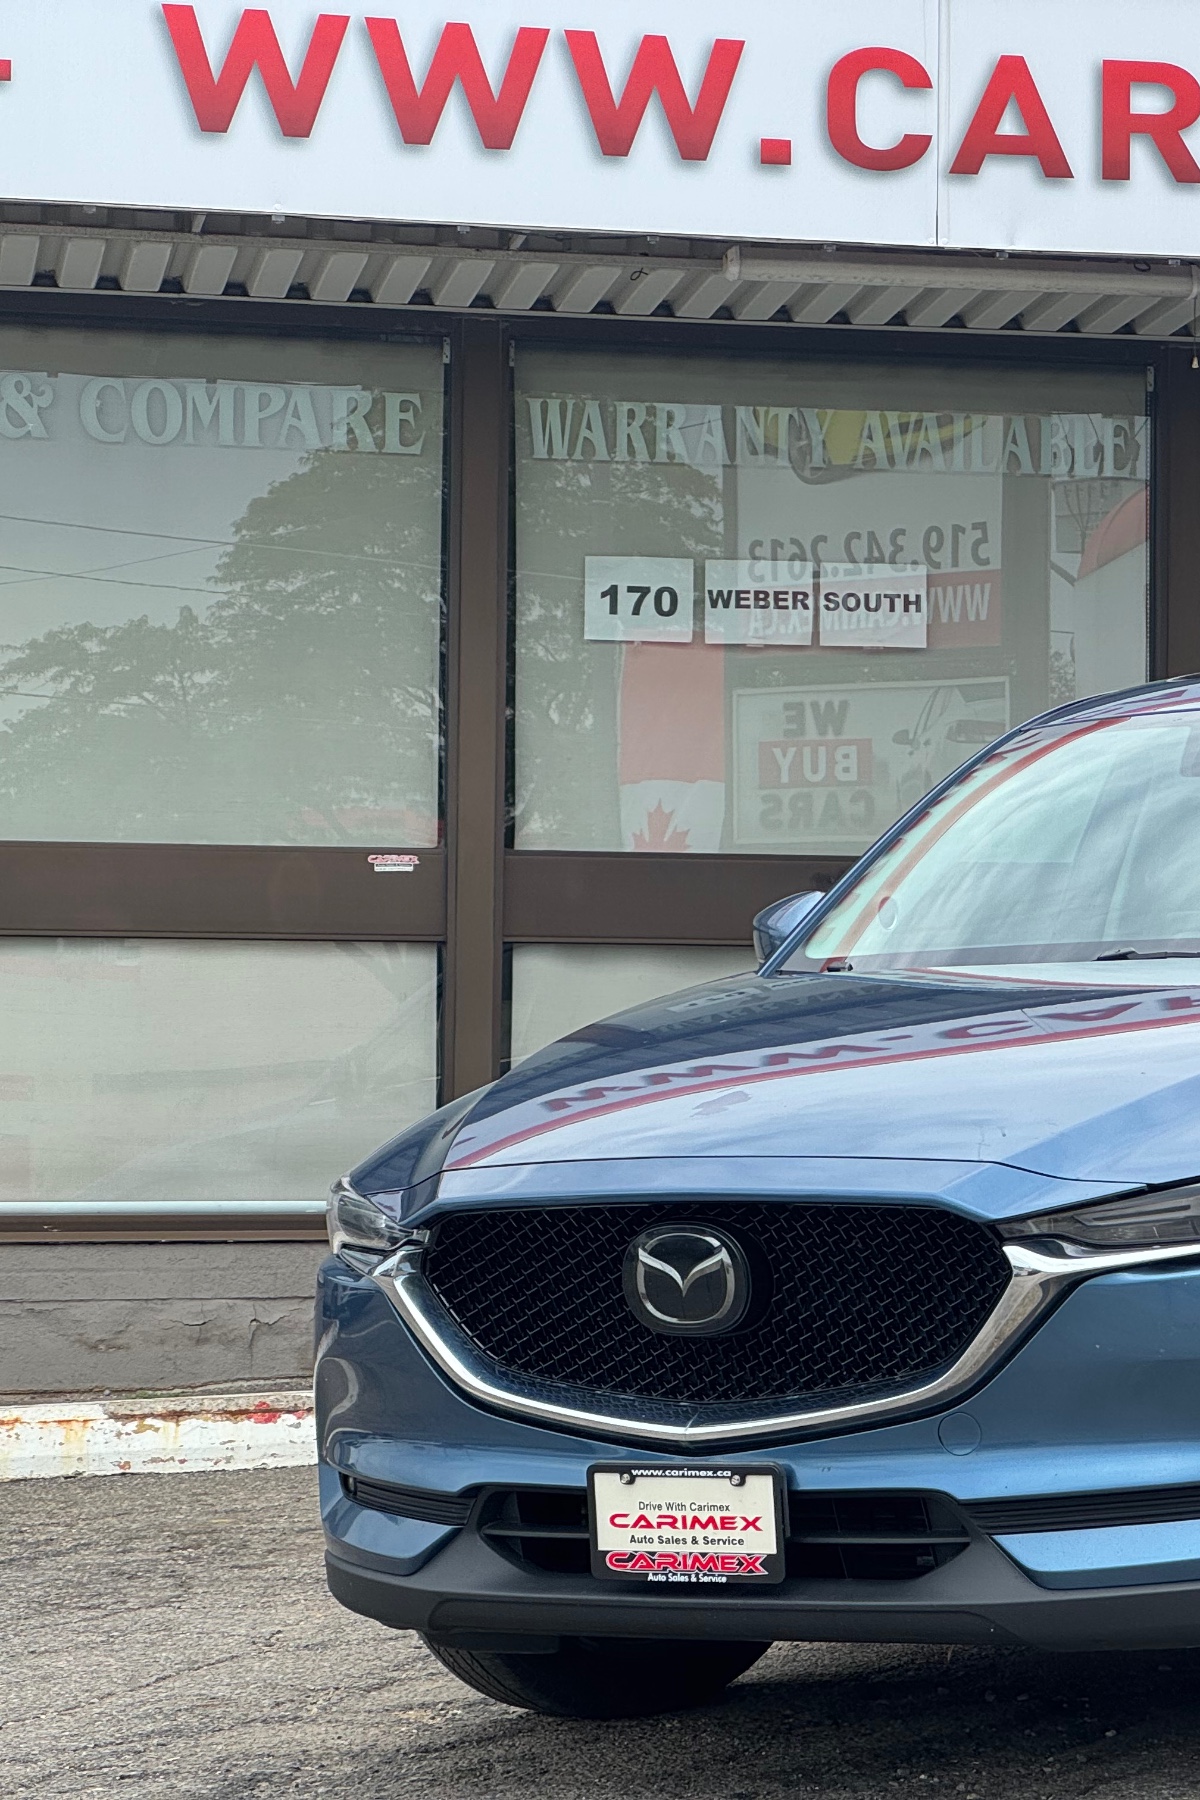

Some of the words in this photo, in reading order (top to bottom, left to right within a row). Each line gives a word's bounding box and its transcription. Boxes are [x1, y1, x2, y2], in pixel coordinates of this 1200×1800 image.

[80, 378, 427, 456] COMPARE
[527, 397, 831, 469] WARRANTY
[853, 411, 1138, 479] AVAILABLE
[598, 584, 679, 618] 170
[706, 588, 810, 611] WEBER
[822, 591, 922, 614] SOUTH
[631, 1468, 732, 1477] www.carimex.ca
[638, 1501, 663, 1511] Drive
[665, 1501, 687, 1511] With
[689, 1502, 731, 1512] Carimex
[609, 1513, 763, 1531] CARIMEX
[629, 1534, 654, 1545] Auto
[657, 1535, 687, 1545] Sales
[691, 1535, 699, 1545] &
[702, 1535, 745, 1546] Service
[605, 1551, 768, 1575] CARIMEX
[647, 1572, 666, 1582] Auto
[668, 1573, 689, 1582] Sales
[690, 1574, 697, 1583] &
[699, 1574, 727, 1583] Service
